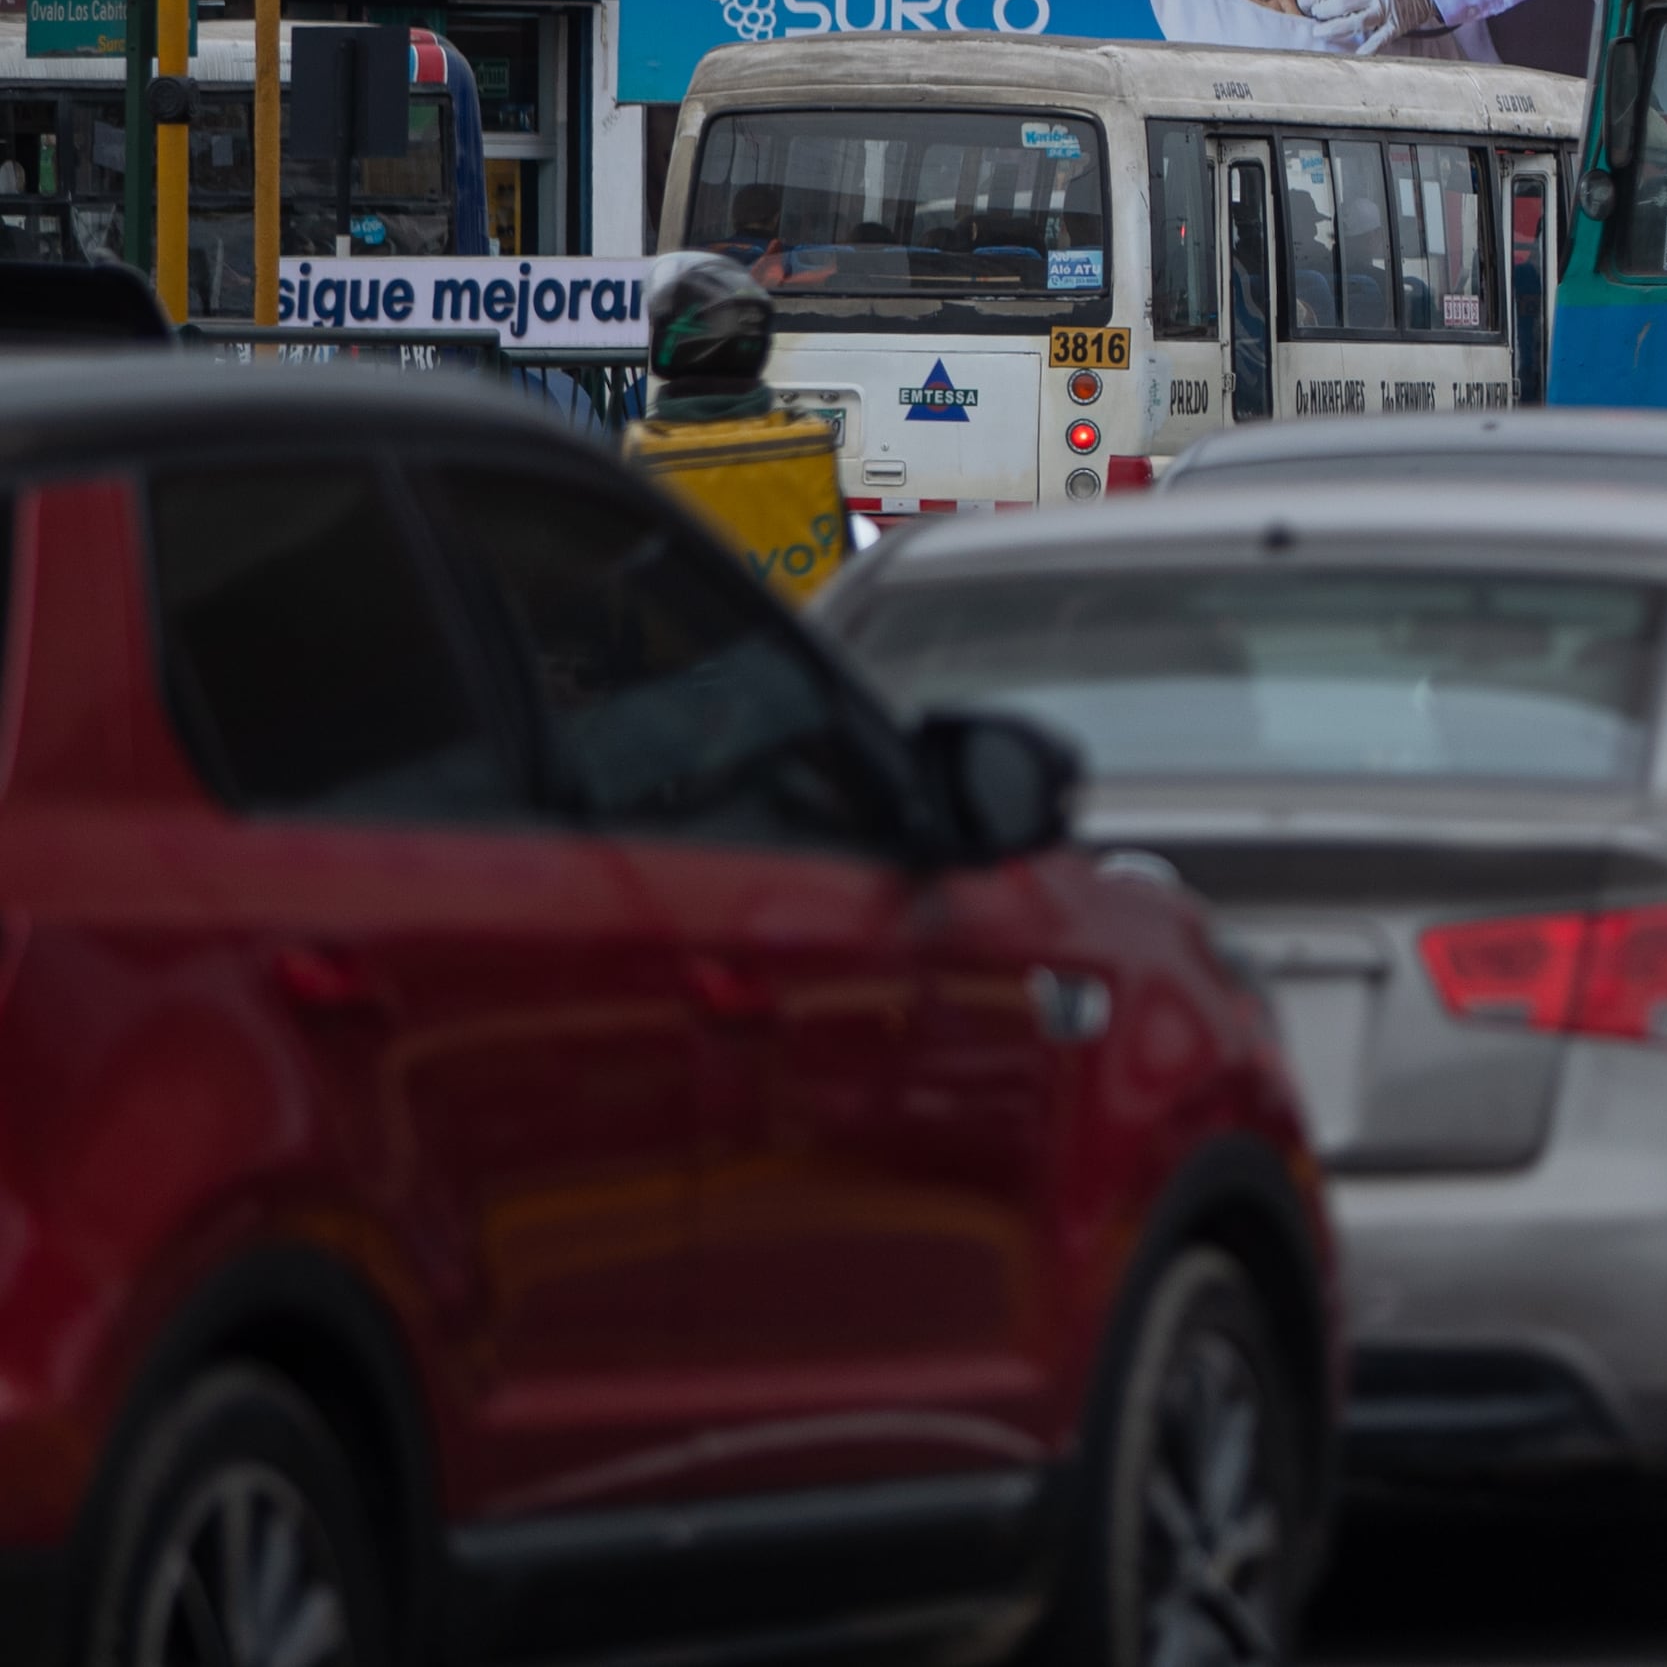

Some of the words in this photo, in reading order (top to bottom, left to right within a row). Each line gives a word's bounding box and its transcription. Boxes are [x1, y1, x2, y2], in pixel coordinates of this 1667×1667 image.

[31, 0, 65, 22] Ovalo
[68, 0, 89, 22] Los
[1053, 332, 1126, 364] 3816
[900, 388, 978, 407] EMTESSA
[1170, 379, 1208, 416] PARDO
[1310, 379, 1365, 415] MIRAFLORES
